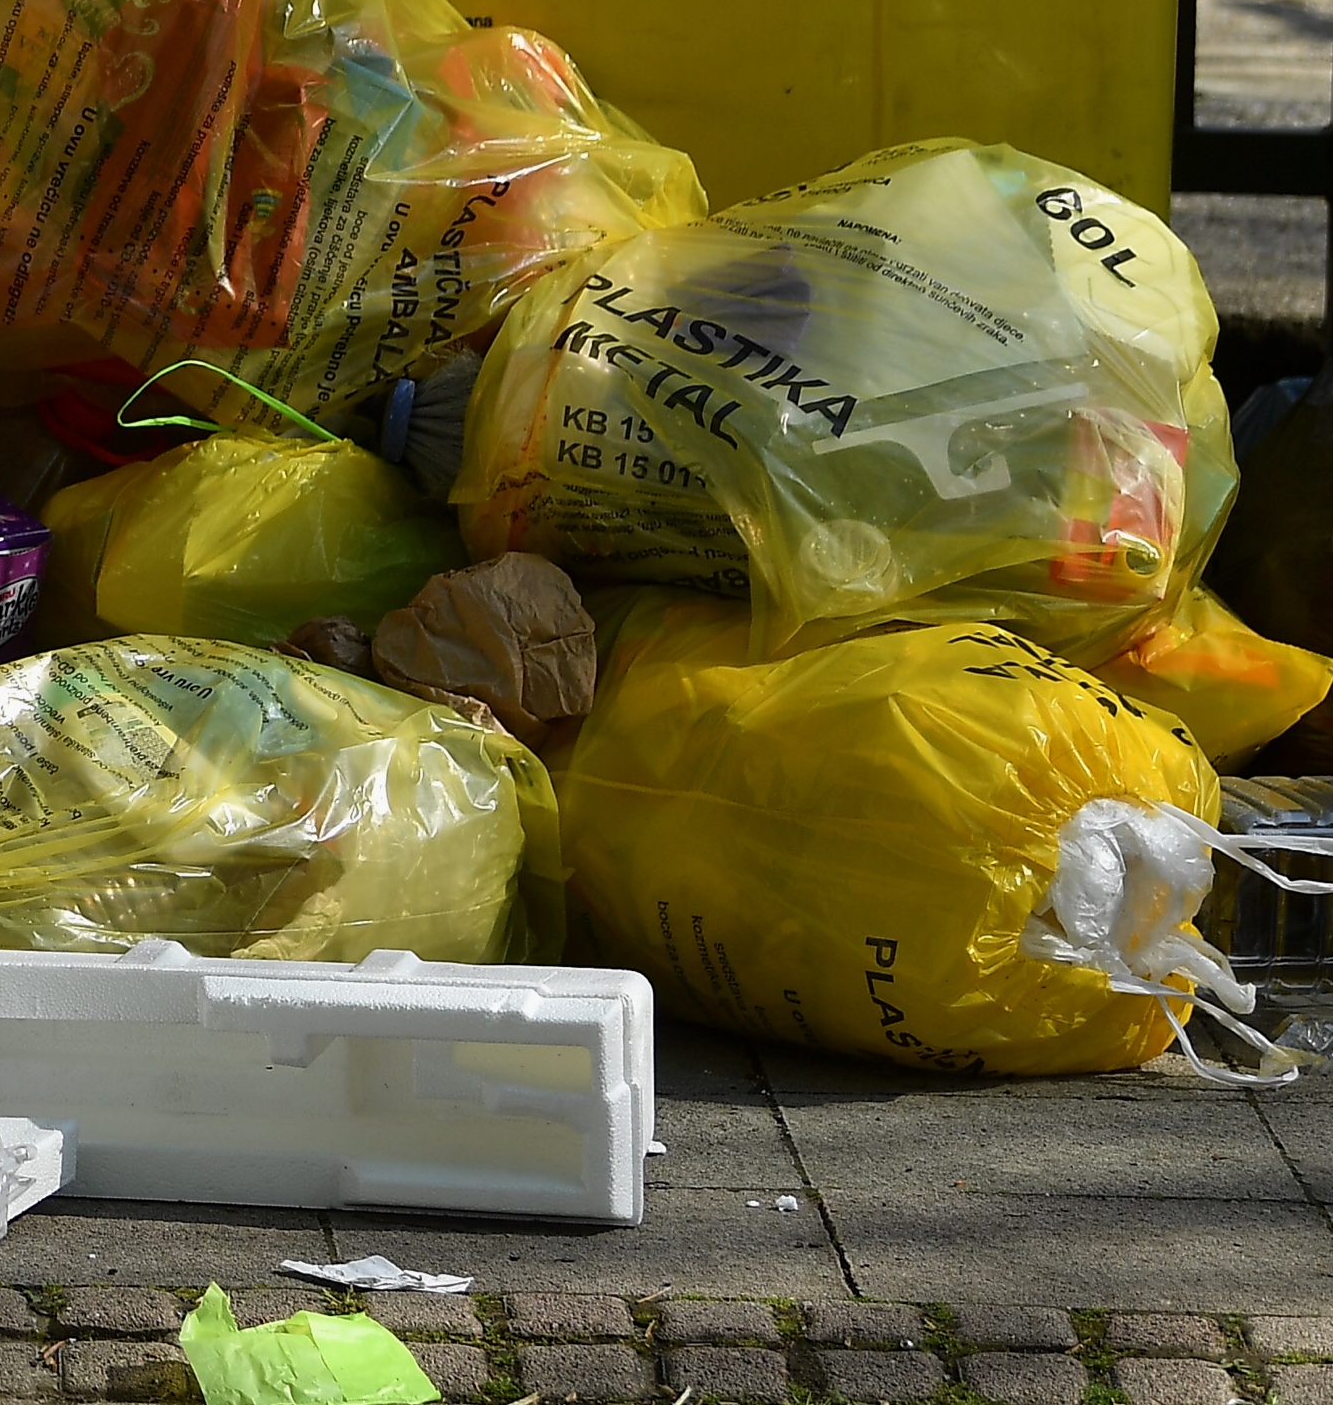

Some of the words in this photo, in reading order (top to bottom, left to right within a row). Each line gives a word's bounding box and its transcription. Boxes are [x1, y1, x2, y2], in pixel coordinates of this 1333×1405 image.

[81, 106, 98, 119] U
[63, 121, 95, 157] ovu
[349, 210, 369, 240] boce
[394, 202, 411, 217] U
[381, 219, 401, 253] ovu
[837, 219, 902, 245] NAPOMENA:
[1035, 187, 1137, 288] 60L
[562, 273, 860, 439] PLASTIKA
[550, 321, 744, 450] METAL
[561, 405, 609, 436] KB
[620, 415, 655, 444] 15
[557, 438, 605, 470] KB
[614, 448, 650, 477] 15
